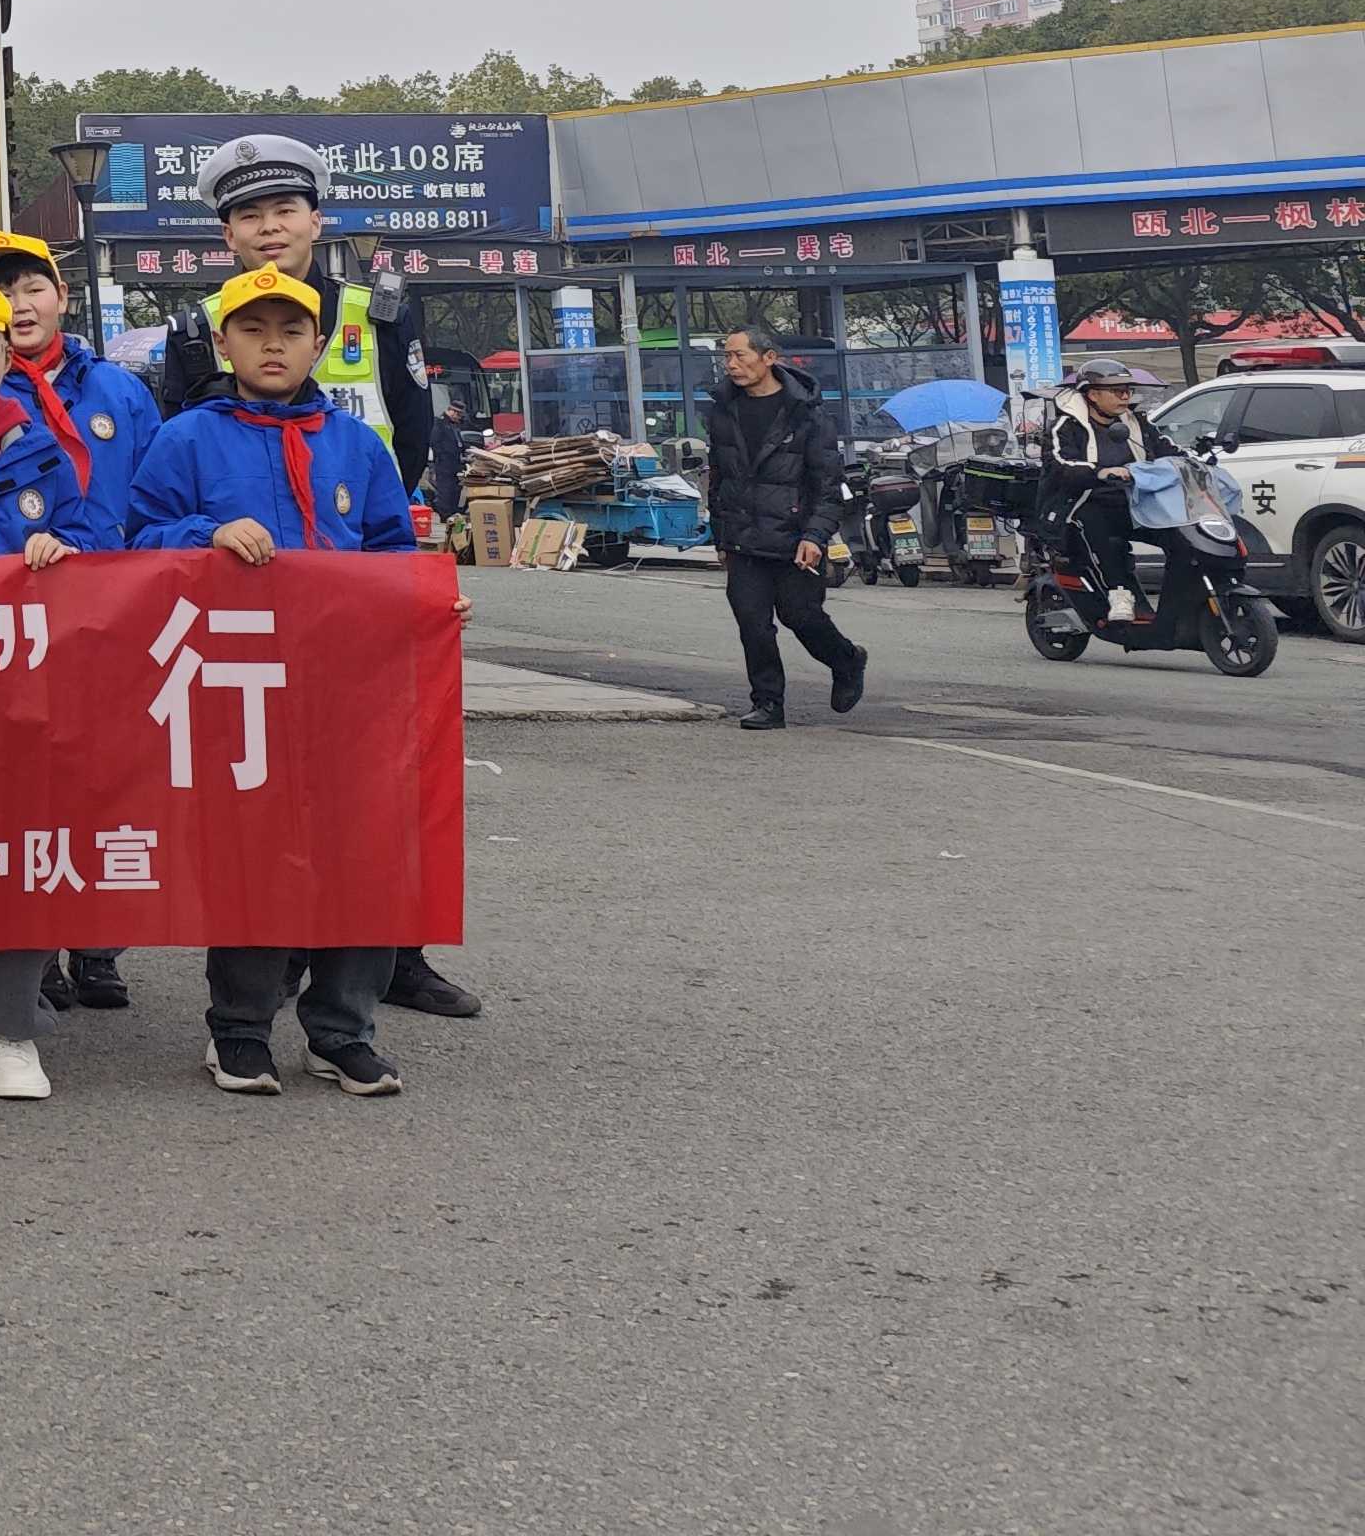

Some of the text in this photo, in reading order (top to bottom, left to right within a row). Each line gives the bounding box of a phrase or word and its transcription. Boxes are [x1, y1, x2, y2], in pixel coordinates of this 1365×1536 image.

[389, 210, 487, 229] 8888 8811
[329, 387, 365, 421] 勤
[1251, 480, 1276, 515] 安
[147, 596, 287, 792] 行
